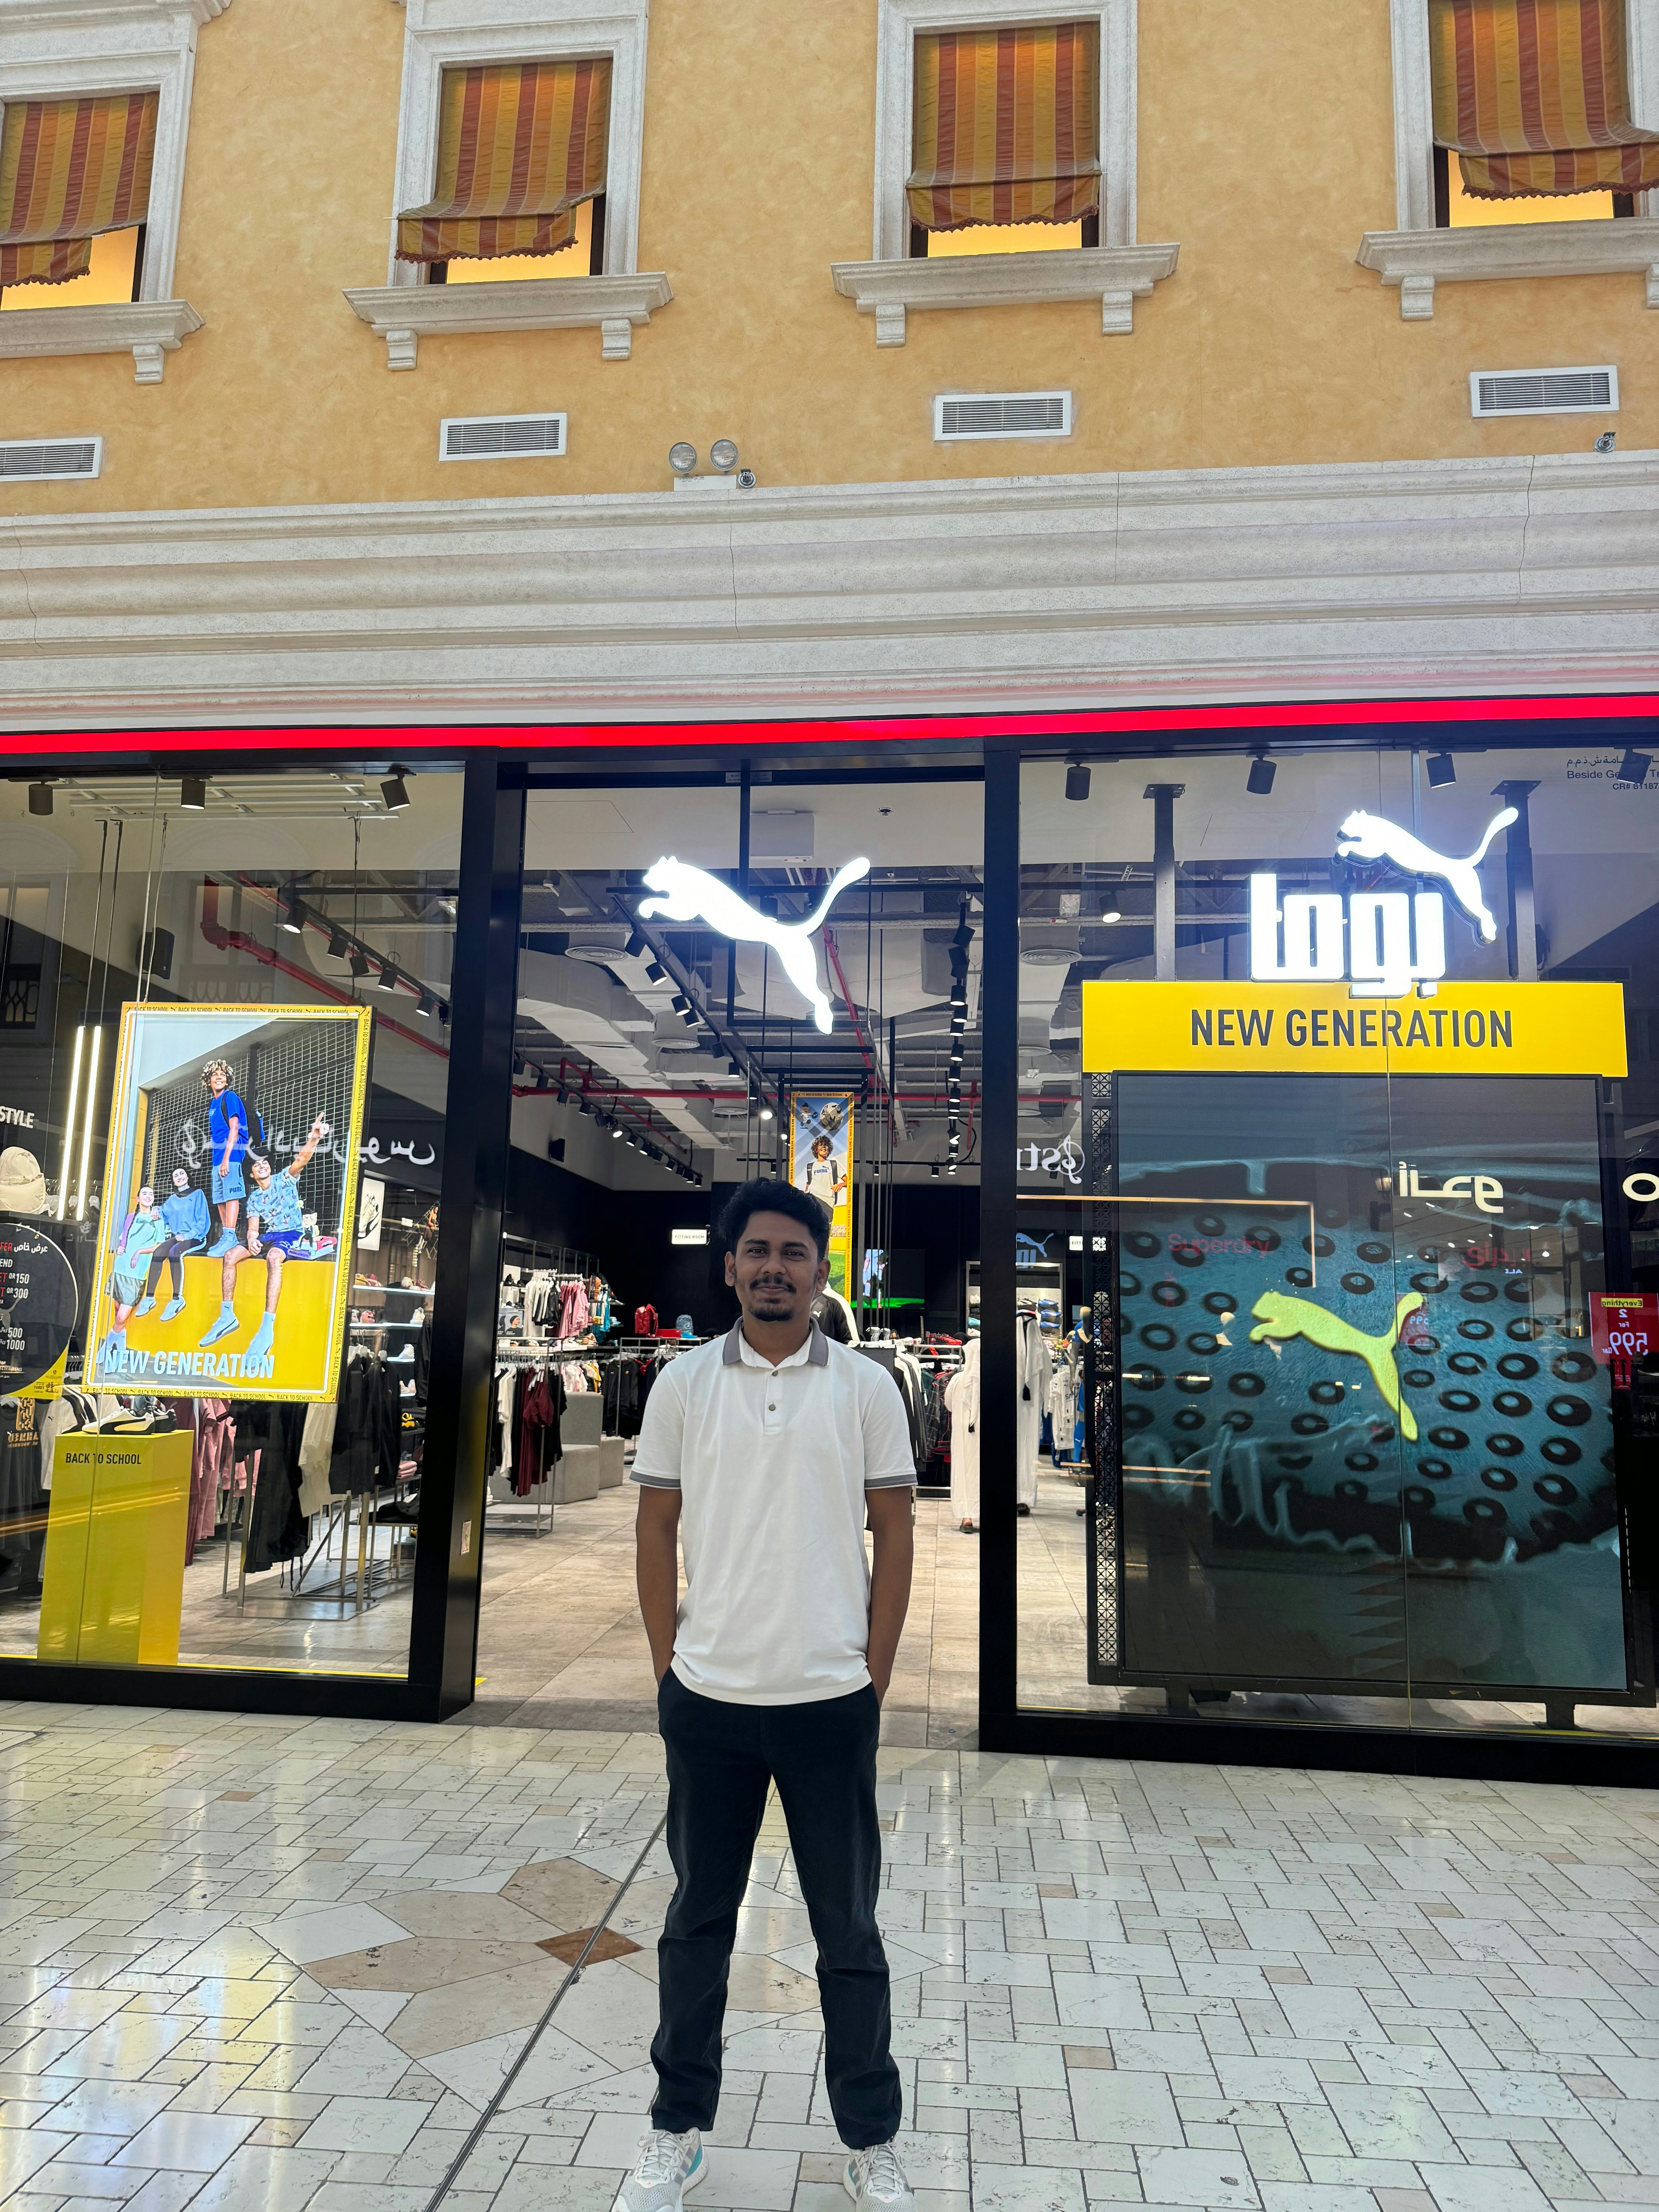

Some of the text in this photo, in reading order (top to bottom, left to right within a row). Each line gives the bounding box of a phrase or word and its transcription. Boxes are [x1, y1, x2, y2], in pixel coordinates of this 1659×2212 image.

[1567, 771, 1603, 779] Beside
[1191, 1009, 1512, 1048] NEW GENERATION
[0, 1106, 35, 1128] STYLE
[14, 1242, 30, 1252] خاص
[31, 1243, 48, 1254] عرض
[0, 1259, 13, 1267] END
[8, 1327, 23, 1338] 500
[7, 1340, 25, 1350] 1000
[105, 1349, 150, 1374] NEW
[153, 1351, 275, 1378] GENERATION
[65, 1453, 90, 1463] BACK
[106, 1454, 141, 1465] SCHOOL
